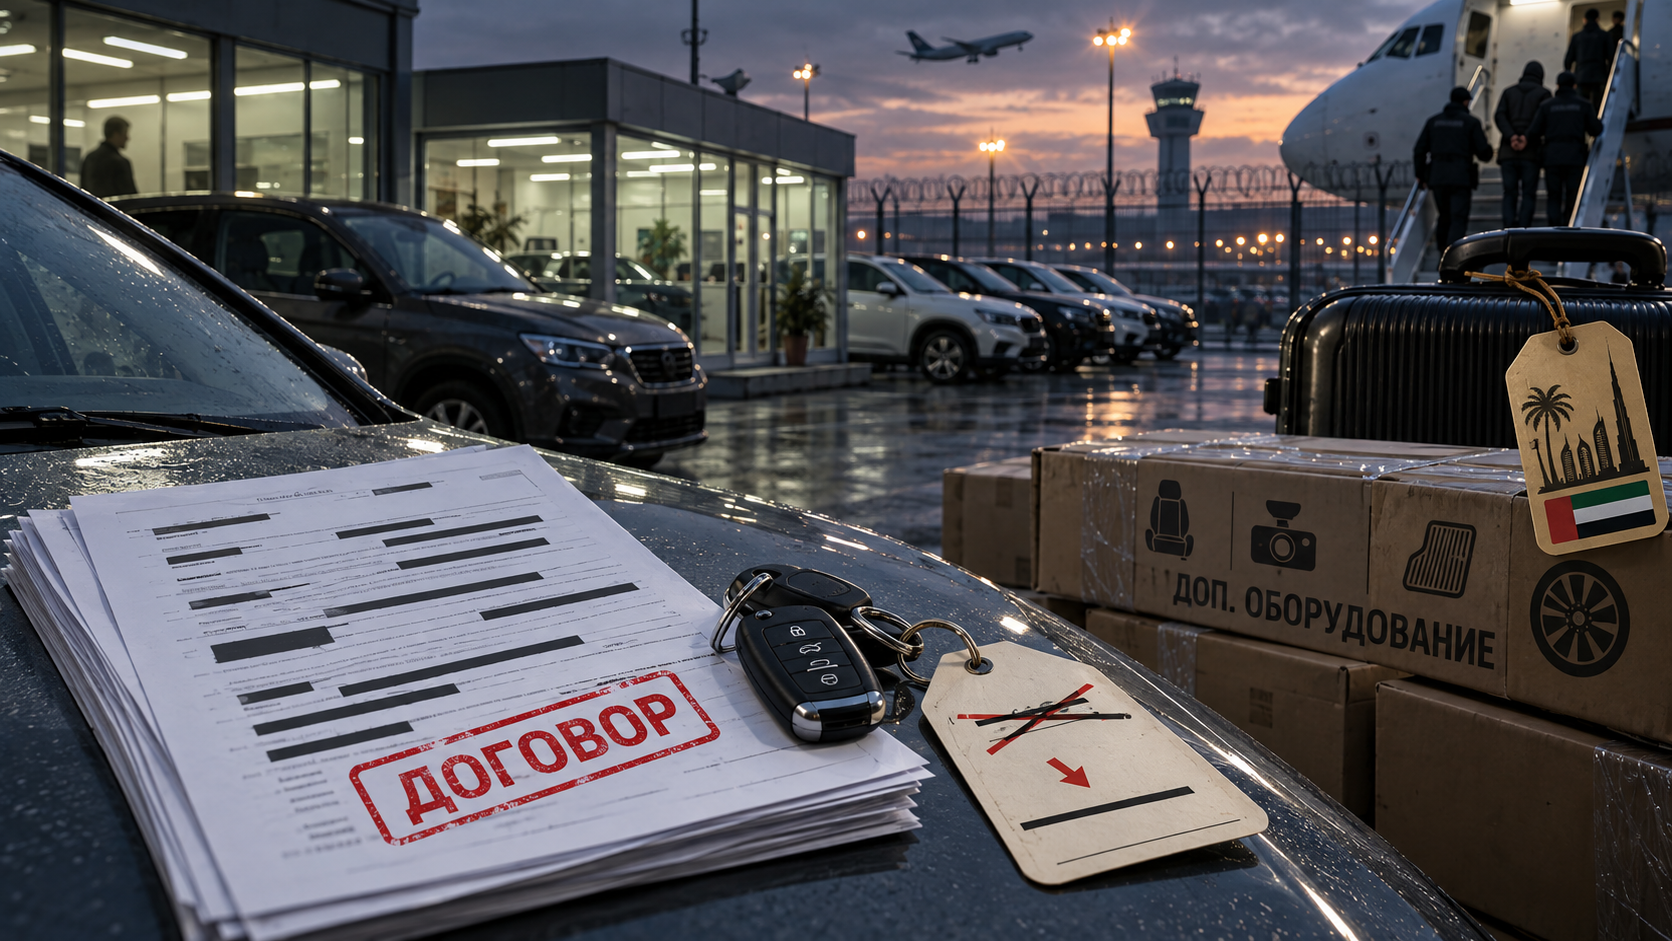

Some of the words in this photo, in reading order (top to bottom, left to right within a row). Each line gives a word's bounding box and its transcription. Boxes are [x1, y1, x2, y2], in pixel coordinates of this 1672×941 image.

[1173, 572, 1236, 614] ДОП.
[1245, 586, 1496, 670] ОБОРУДОВАНИЕ
[399, 694, 677, 827] ДОГОВОР
